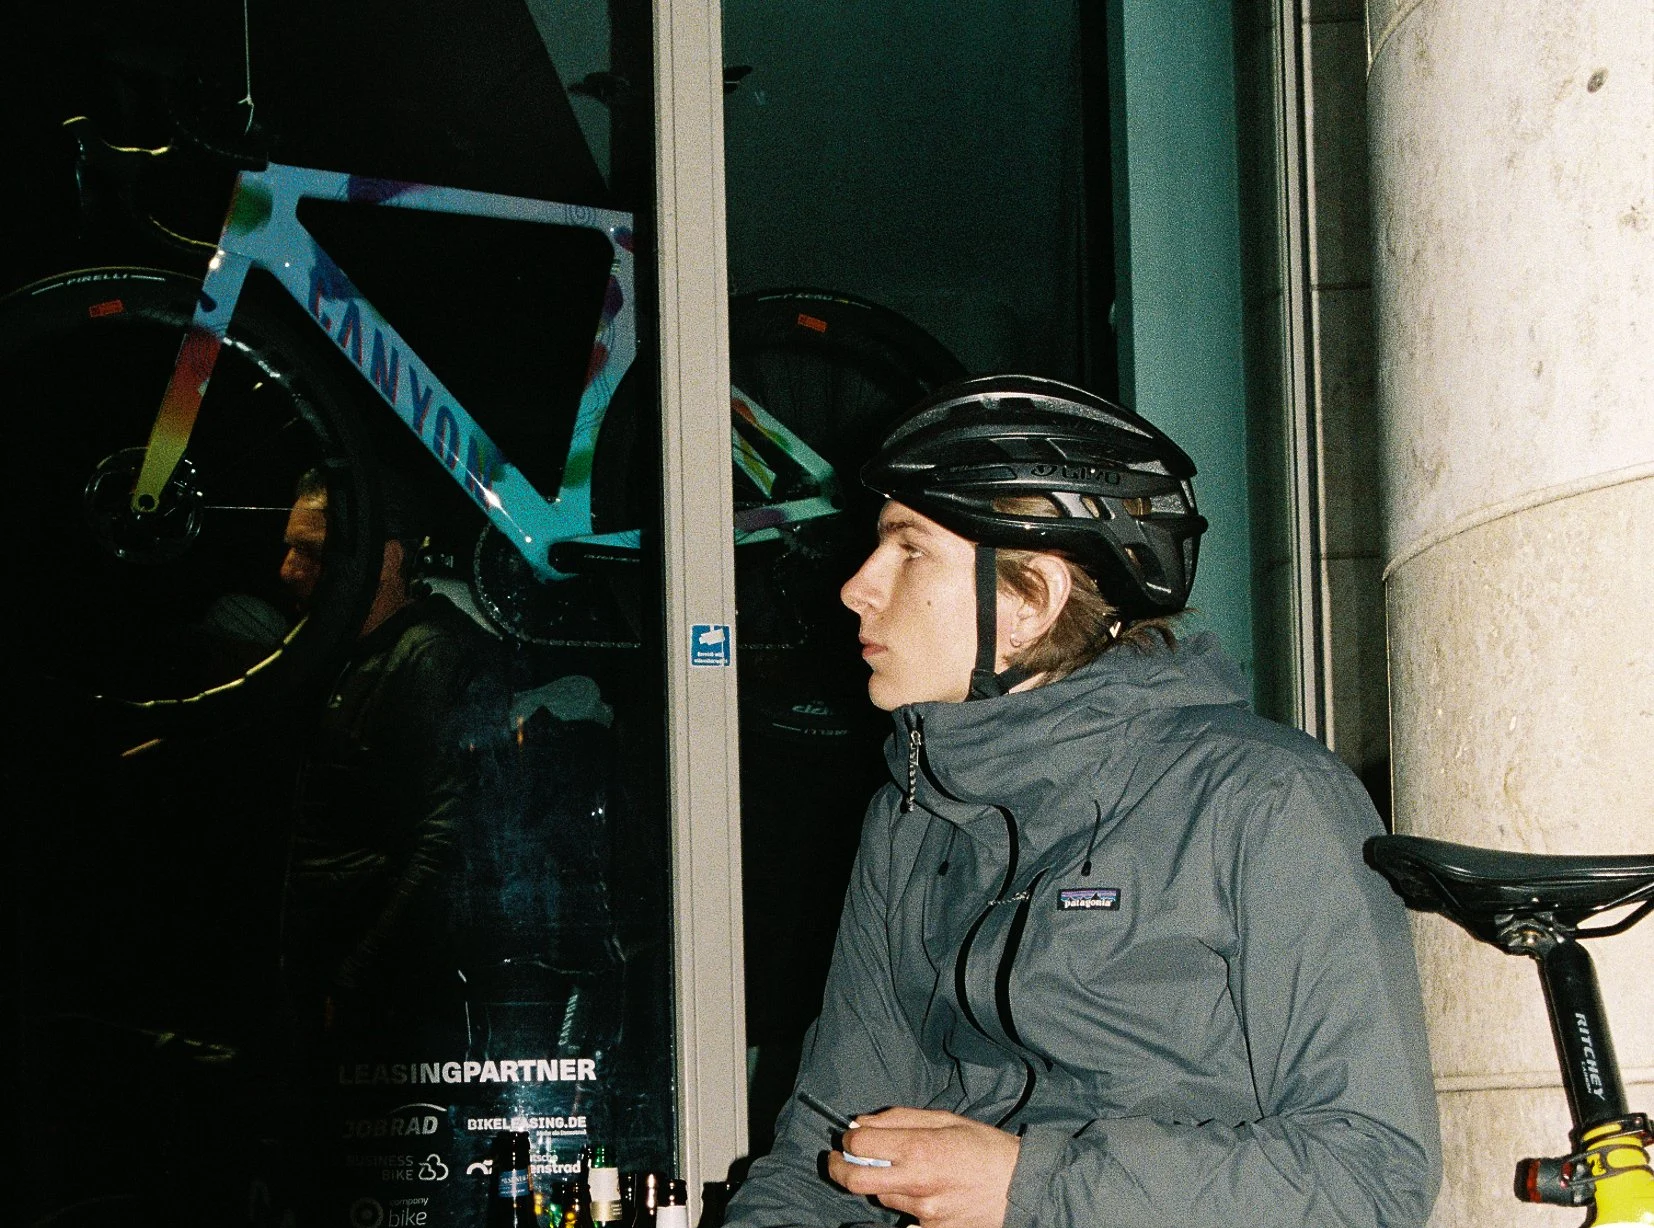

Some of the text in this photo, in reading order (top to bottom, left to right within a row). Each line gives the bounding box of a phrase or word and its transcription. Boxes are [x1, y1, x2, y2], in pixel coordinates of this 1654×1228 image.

[66, 273, 128, 285] PIRELLI
[308, 264, 494, 510] CANYON
[1064, 899, 1111, 909] patagonia
[1575, 1012, 1605, 1101] RITCHEY
[338, 1058, 597, 1085] LEASINGPARTNER
[342, 1115, 439, 1139] JOBRAD
[467, 1116, 587, 1131] BIKELEASING.DE
[382, 1169, 414, 1181] BIKE
[530, 1159, 581, 1174] enstrad
[388, 1207, 428, 1228] bike
